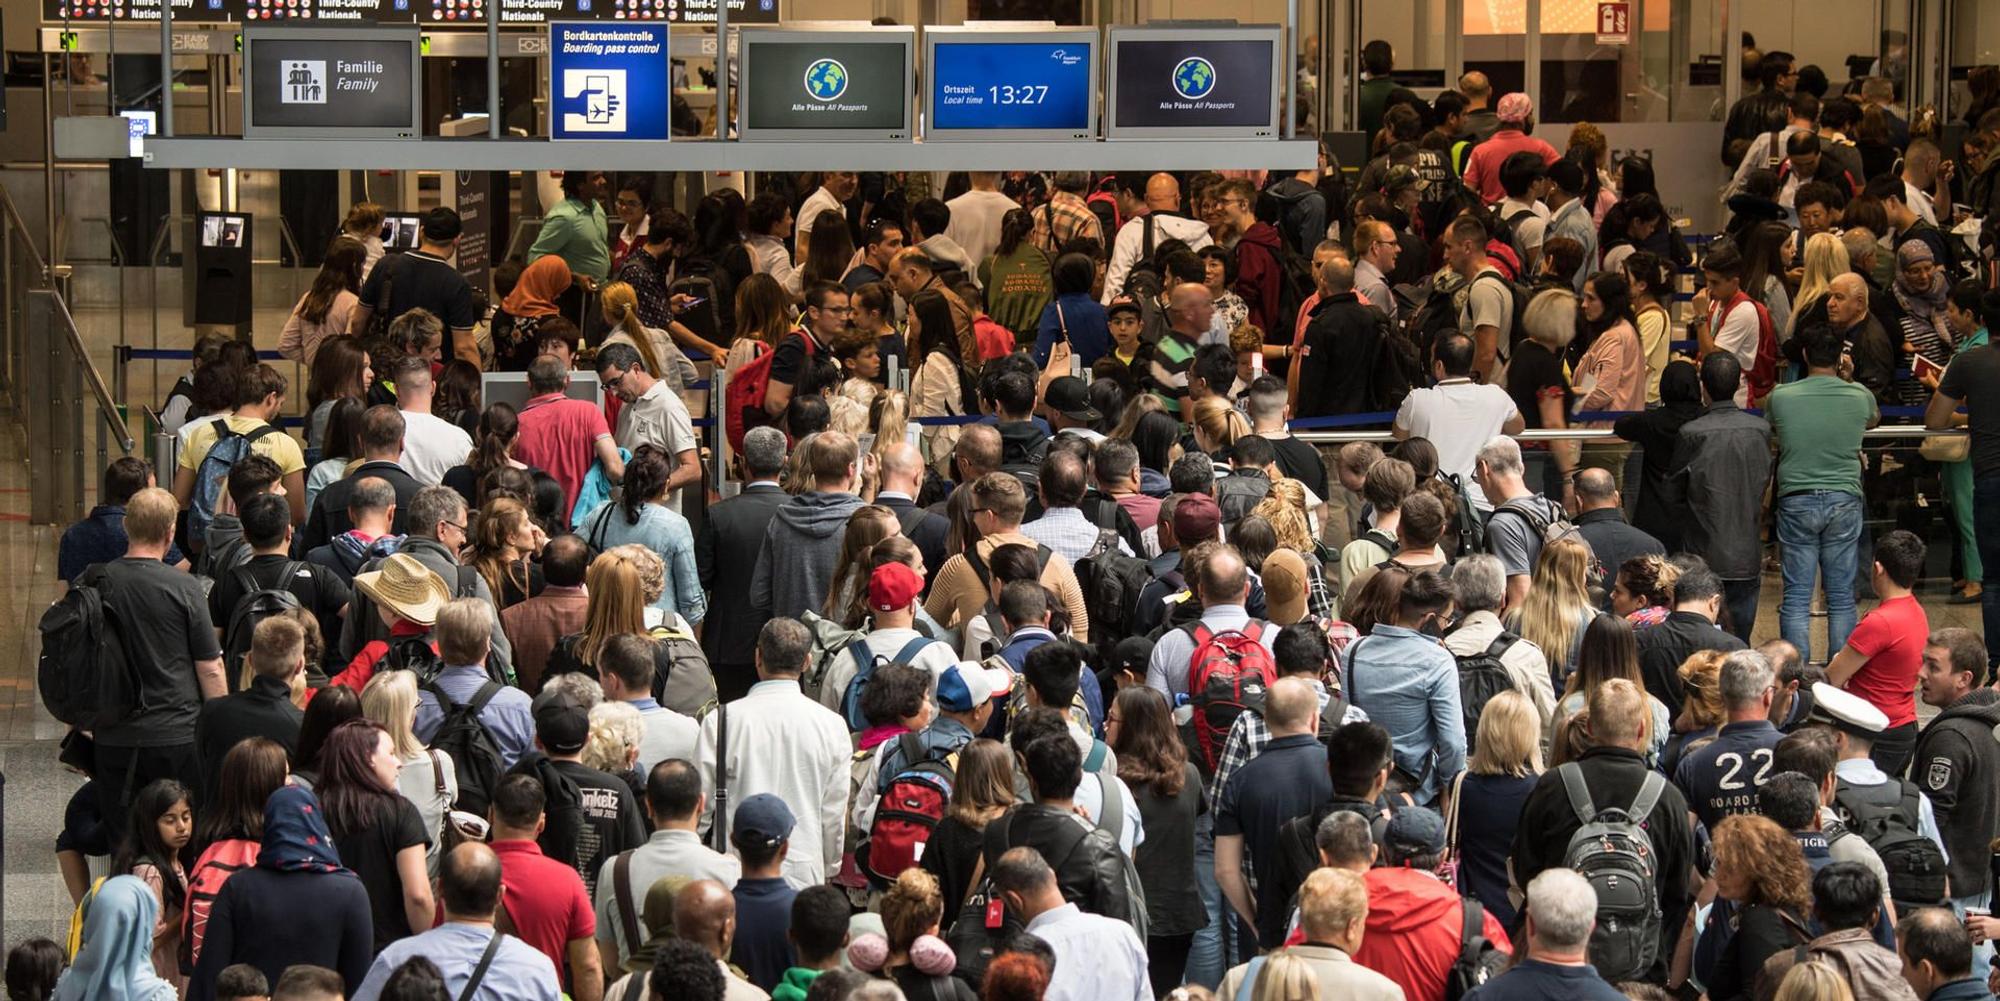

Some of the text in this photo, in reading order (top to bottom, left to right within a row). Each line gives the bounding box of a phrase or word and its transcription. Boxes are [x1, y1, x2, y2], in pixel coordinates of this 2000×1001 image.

[502, 0, 563, 11] Third-Country
[318, 10, 362, 19] Nationals
[501, 11, 545, 21] Nationals
[564, 30, 653, 41] Bordkartenkontrolle
[563, 42, 603, 55] Boarding
[604, 44, 627, 55] pass
[627, 43, 660, 53] control
[337, 60, 383, 73] Familie
[337, 77, 379, 93] Family
[943, 85, 975, 94] Ortszeit
[943, 95, 984, 105] Local time
[990, 85, 1048, 104] 13:27
[792, 103, 805, 111] Alle
[826, 103, 836, 111] All
[837, 103, 868, 112] Passports
[1194, 101, 1204, 109] All
[1204, 101, 1235, 110] Passports
[1715, 748, 1774, 790] 22
